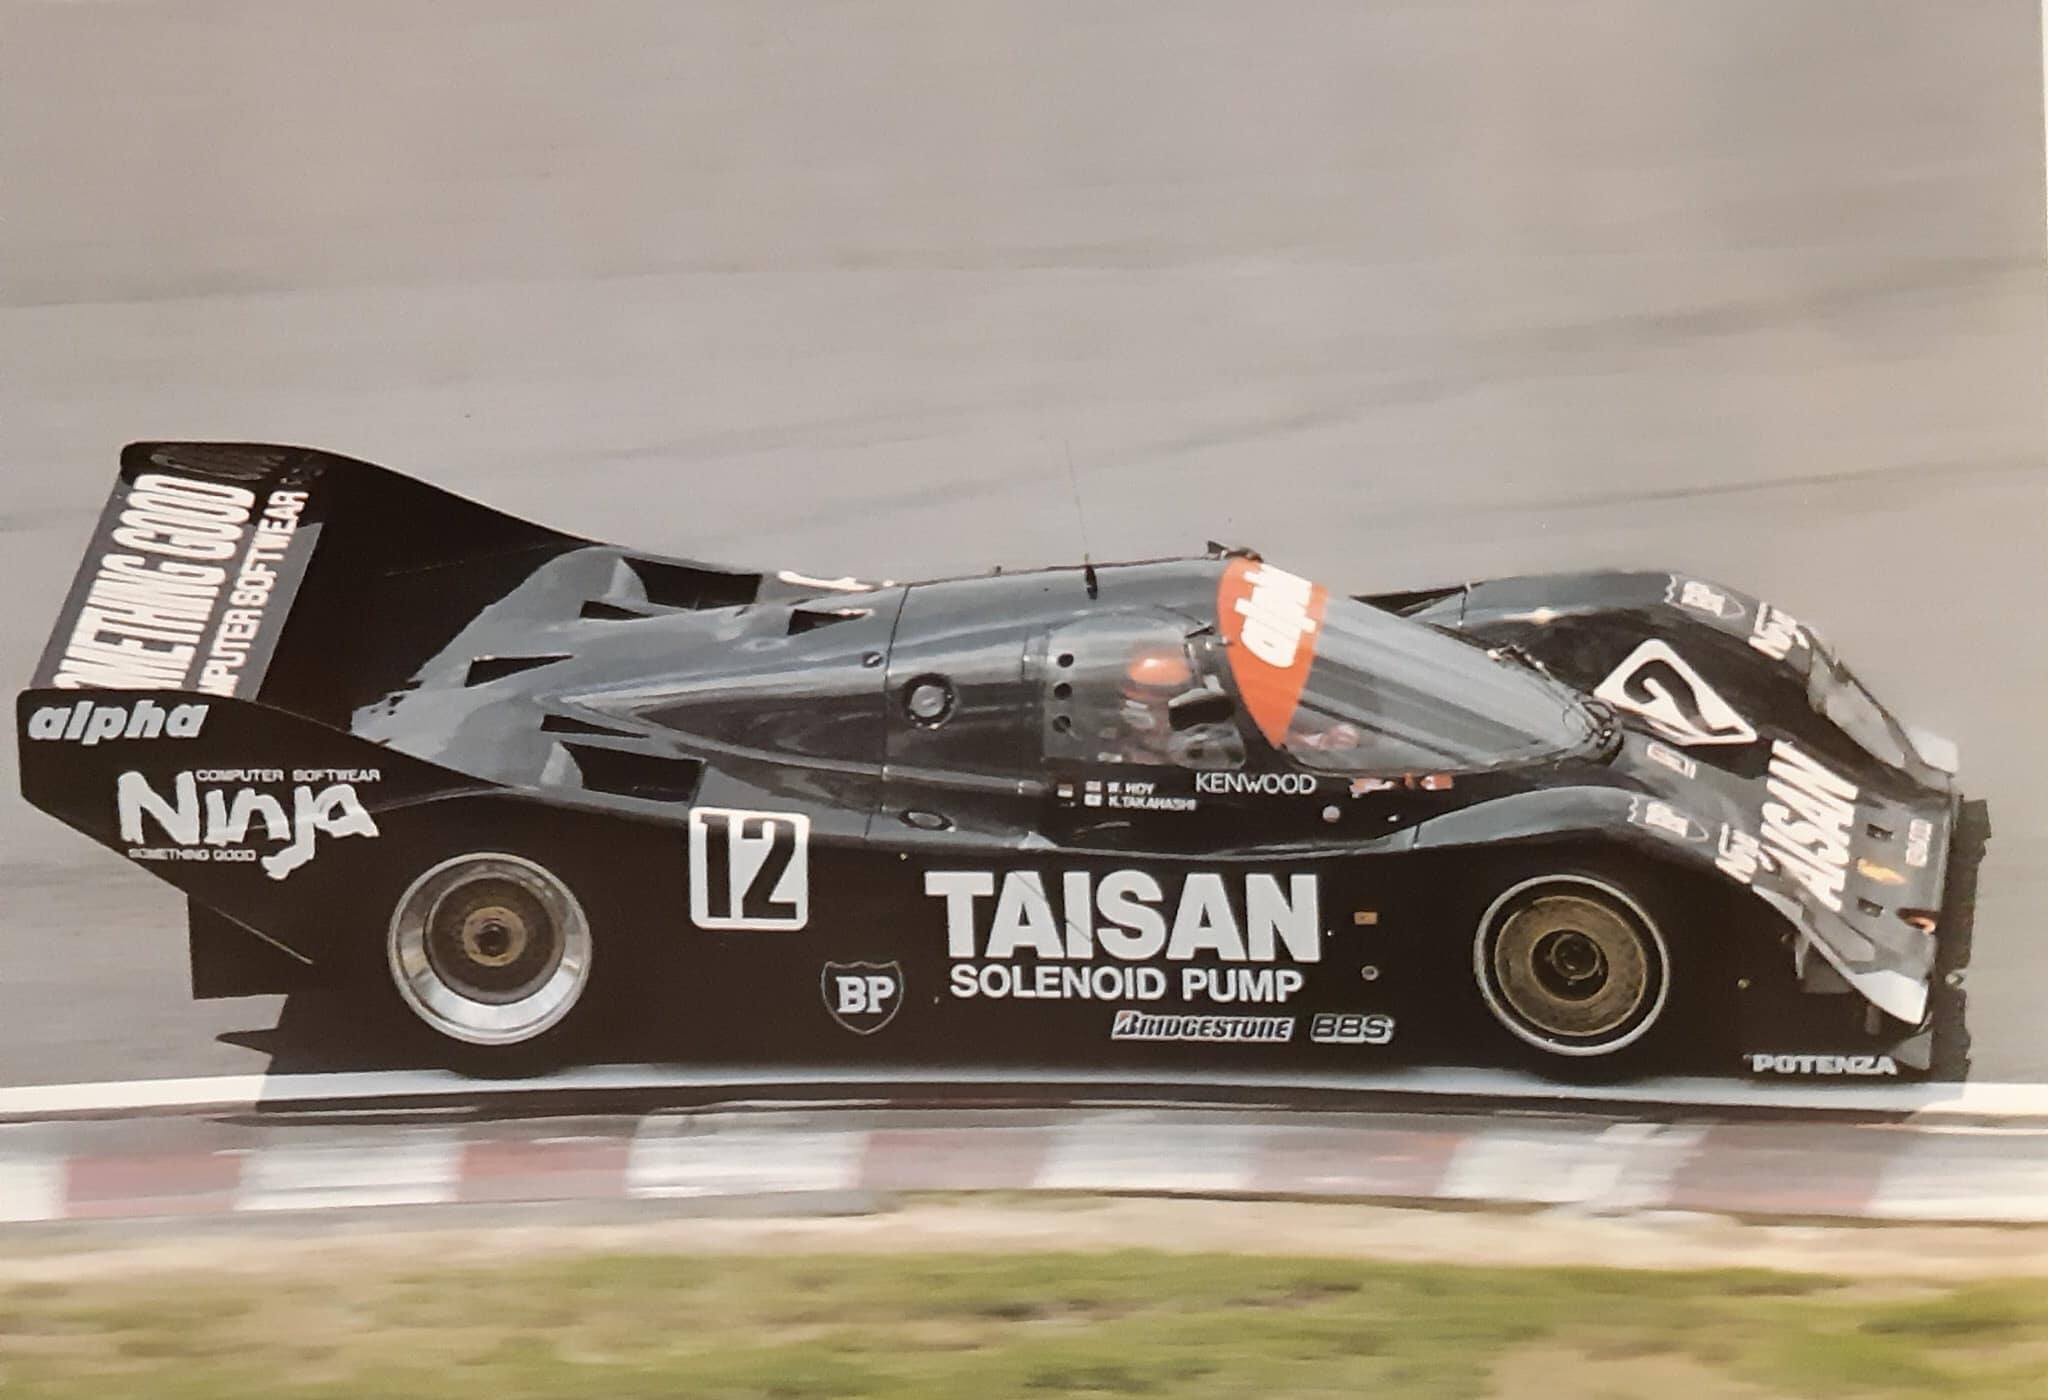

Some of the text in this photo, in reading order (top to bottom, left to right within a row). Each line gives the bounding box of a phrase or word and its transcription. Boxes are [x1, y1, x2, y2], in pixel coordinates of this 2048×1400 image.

[112, 474, 256, 561] GOOD
[229, 490, 310, 607] SOFTWEAR
[28, 700, 209, 746] alpha
[196, 769, 381, 782] COMPUTER SOFTWEAR
[1195, 773, 1317, 795] KENWOOD
[117, 770, 380, 880] Ninja
[128, 848, 257, 861] SOMETHING GOOD
[699, 814, 798, 920] 12
[924, 870, 1321, 963] TAISAN
[835, 975, 896, 1014] BP
[950, 965, 1303, 1002] SOLENOID PUMP
[1113, 1010, 1293, 1040] BRIDGESTONE
[1311, 1013, 1394, 1041] BBS
[1752, 1053, 1898, 1075] POTENZA
